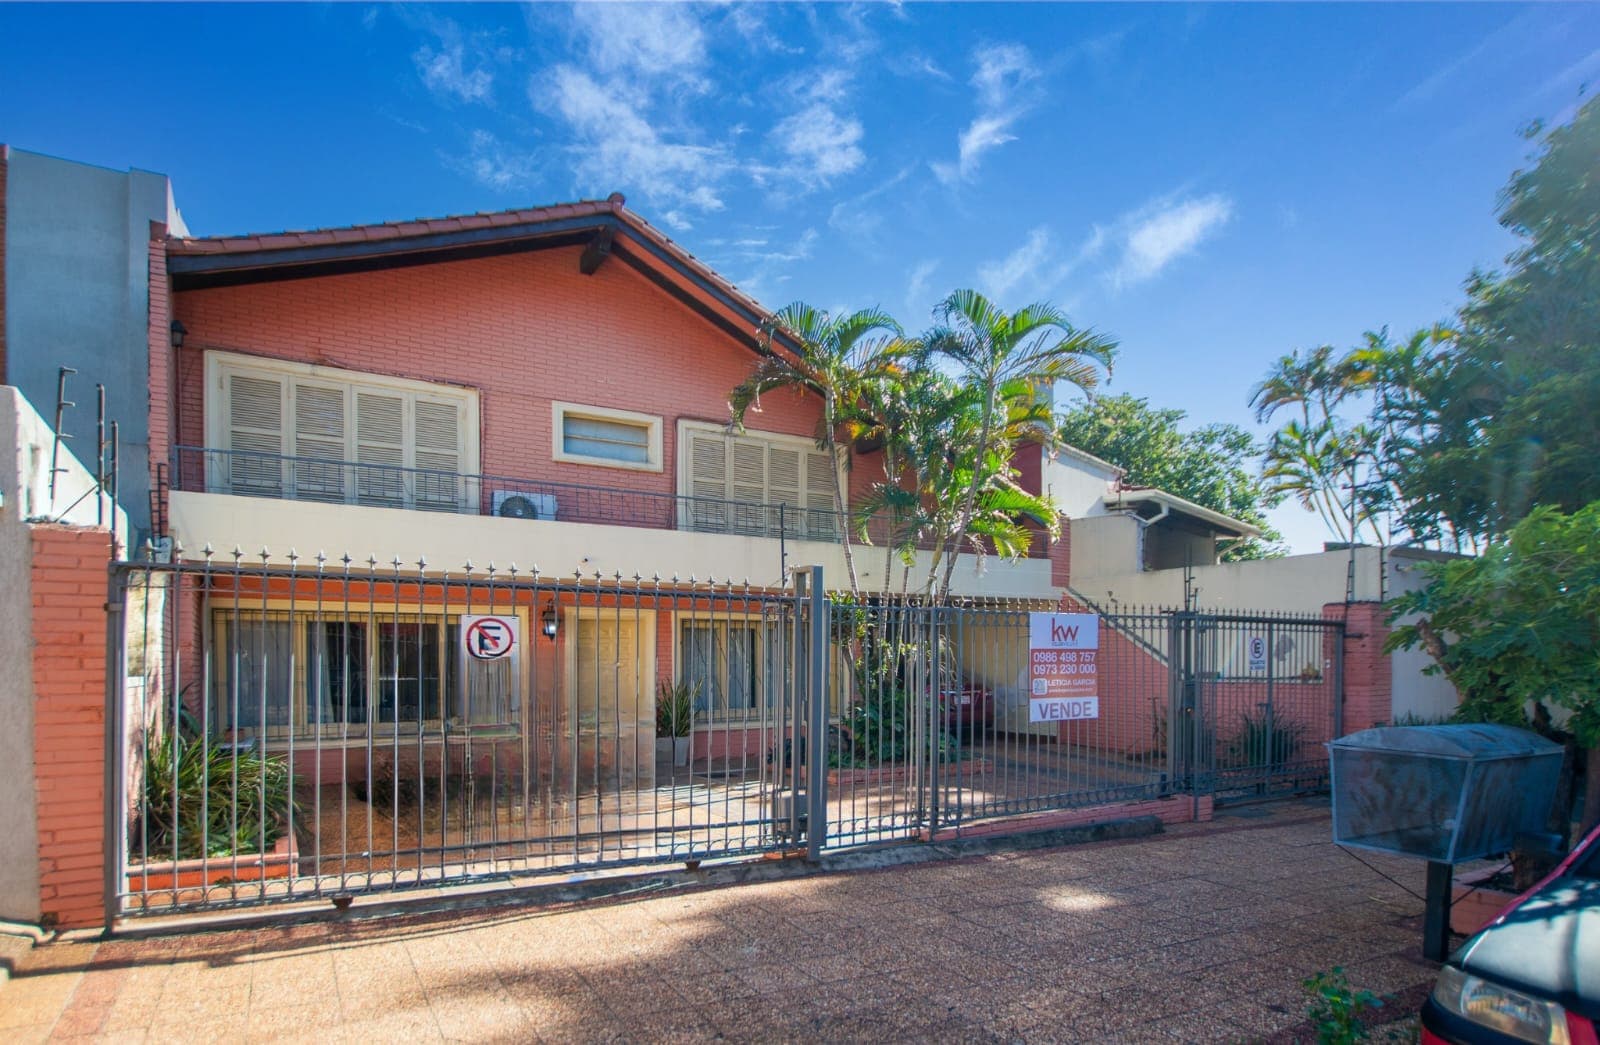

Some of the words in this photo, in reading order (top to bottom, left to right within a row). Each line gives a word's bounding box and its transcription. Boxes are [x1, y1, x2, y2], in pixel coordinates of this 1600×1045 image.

[1051, 617, 1079, 642] kw
[1254, 642, 1261, 654] E
[1033, 652, 1057, 663] 0986
[1059, 652, 1077, 662] 498
[1079, 652, 1096, 662] 757
[1033, 664, 1057, 675] 0973
[1059, 664, 1077, 674] 230
[1079, 664, 1096, 674] 000
[1039, 701, 1092, 719] VENDE
